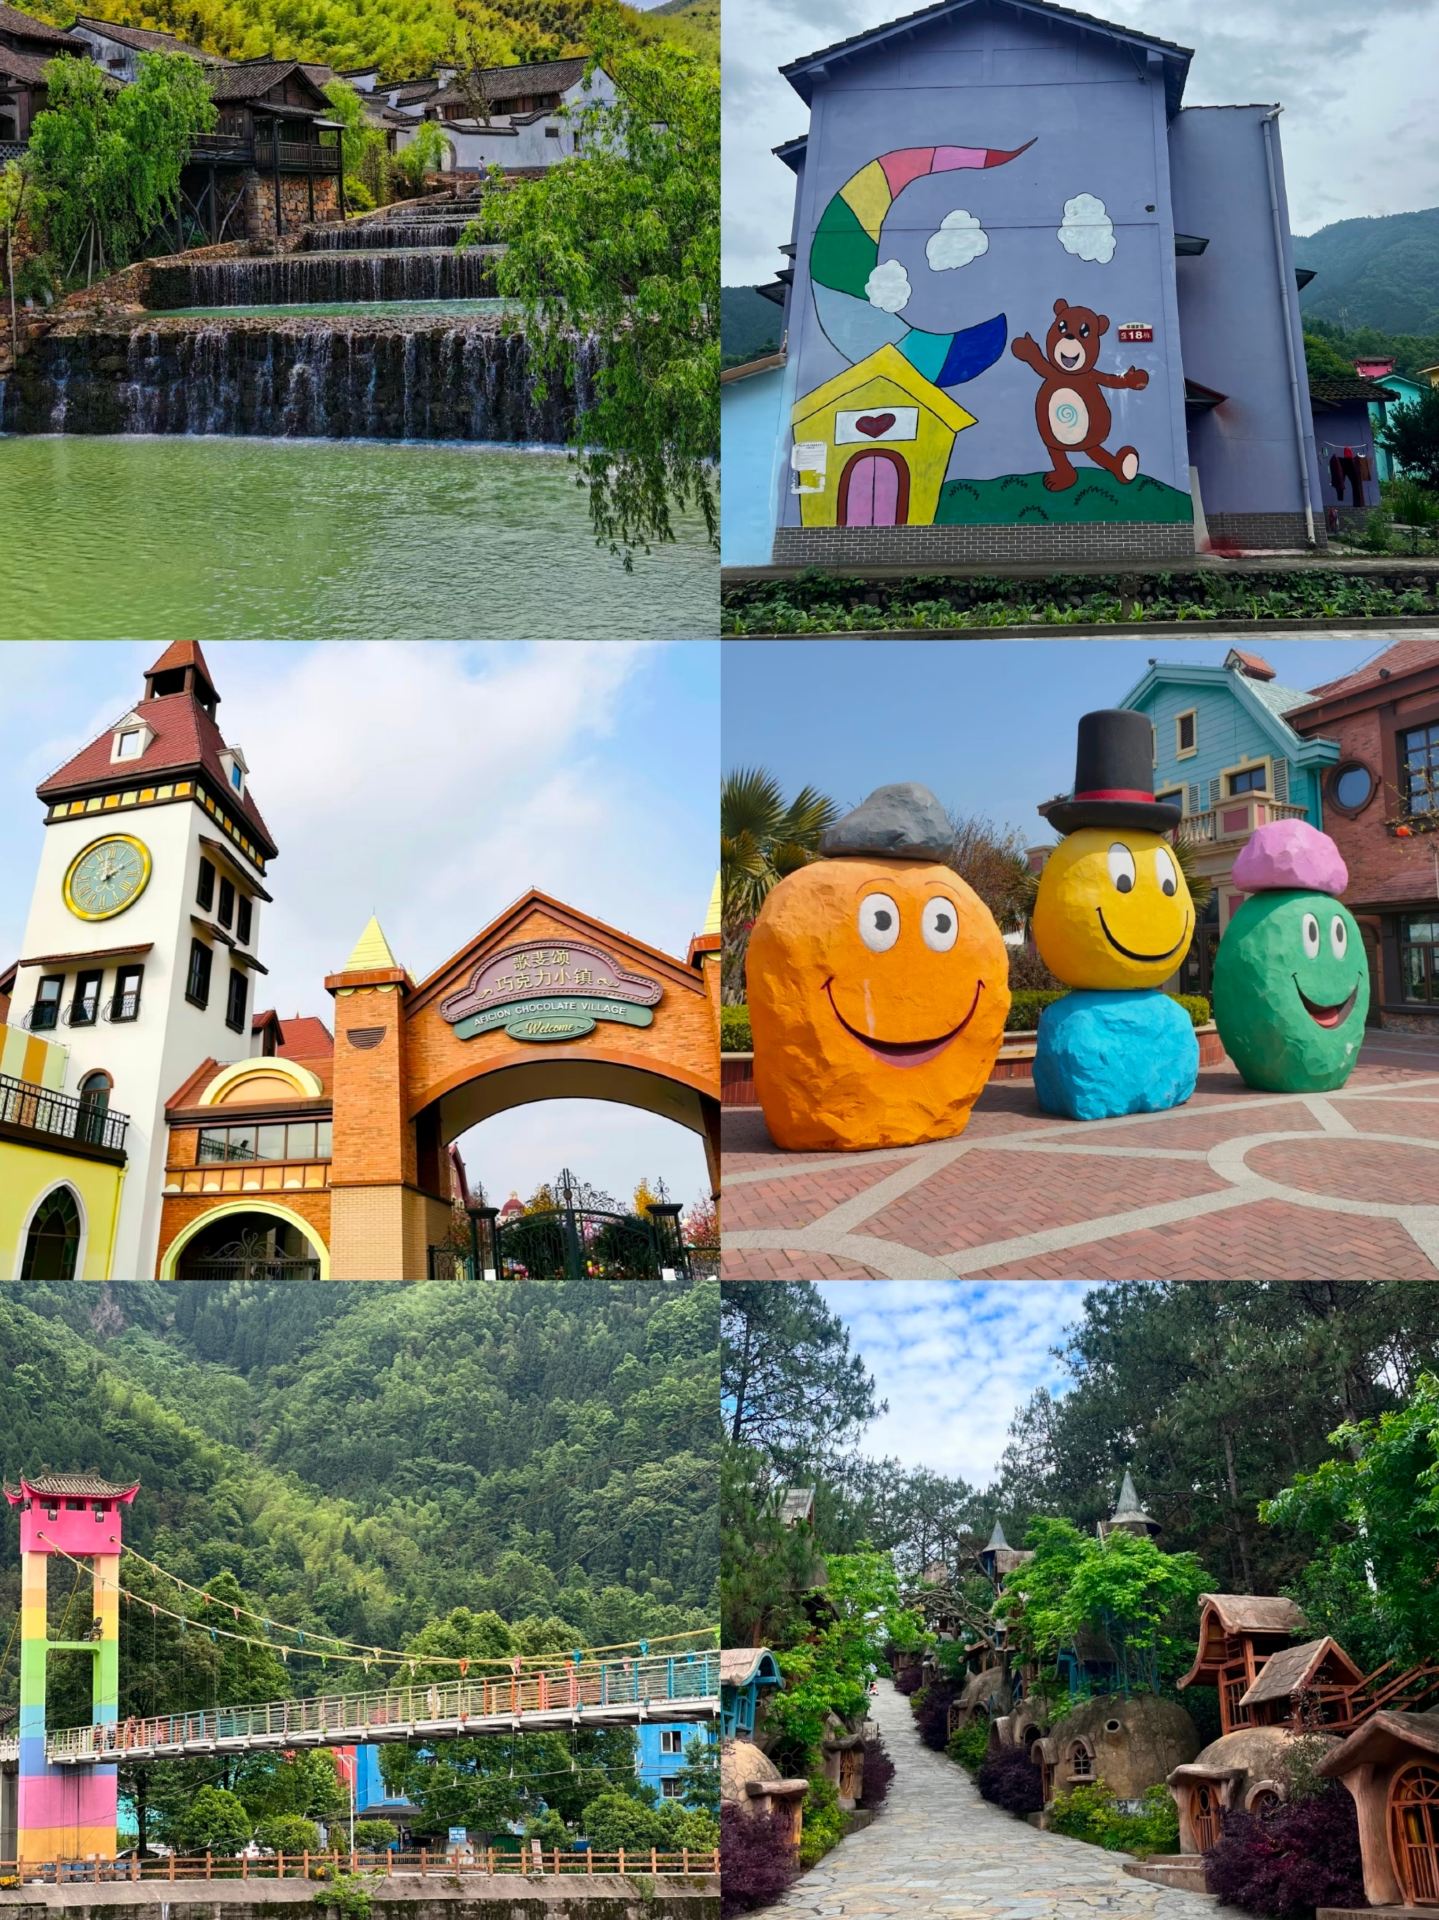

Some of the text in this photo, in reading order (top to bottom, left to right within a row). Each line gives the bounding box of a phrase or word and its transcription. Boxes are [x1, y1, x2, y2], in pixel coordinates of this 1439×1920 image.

[513, 949, 571, 970] 歌斐颂
[495, 967, 593, 992] 巧克力小镇
[474, 1001, 627, 1027] AFICION CHOCOLATE VILLAGE
[524, 1022, 575, 1035] Welcome
